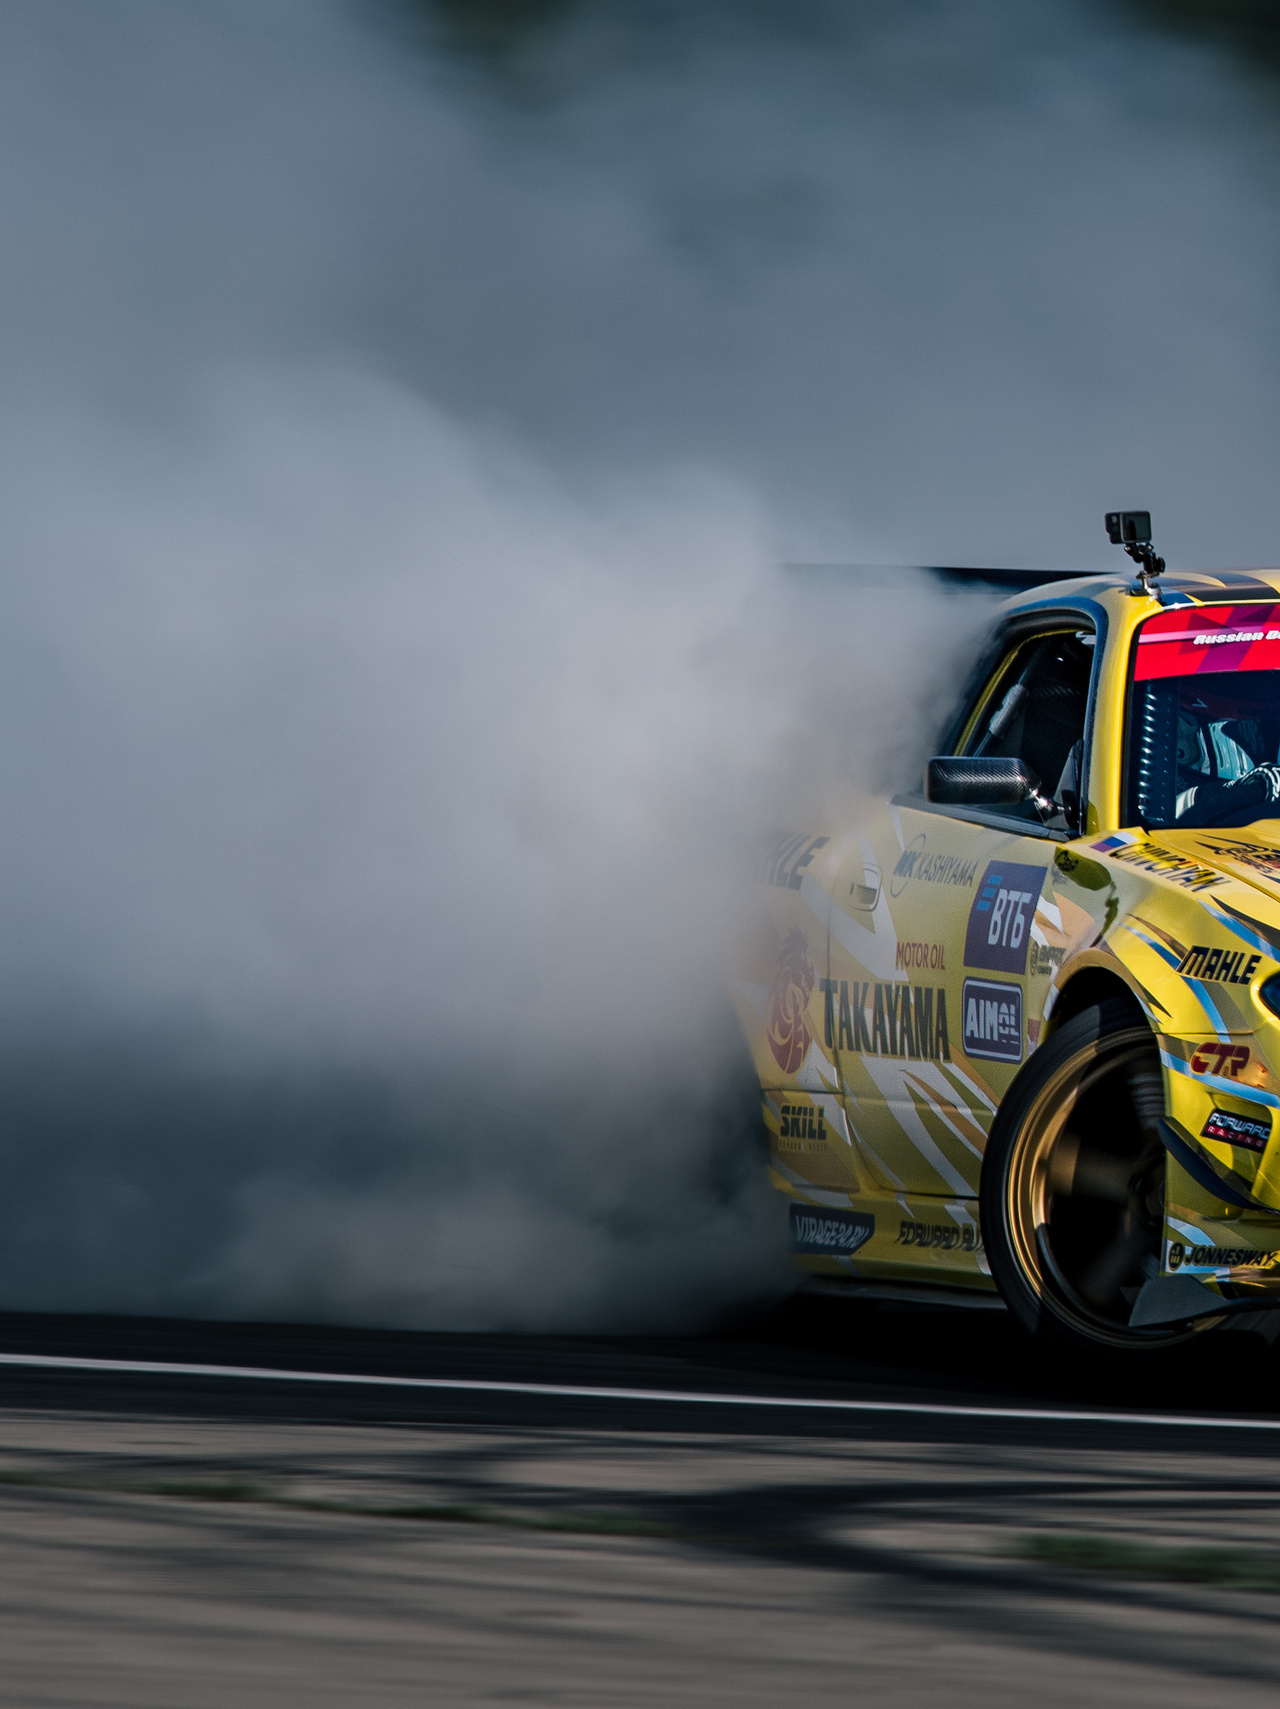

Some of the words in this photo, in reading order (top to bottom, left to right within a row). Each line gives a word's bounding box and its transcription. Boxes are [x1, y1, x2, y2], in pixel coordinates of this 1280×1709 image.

[1193, 630, 1263, 645] Russian
[896, 941, 928, 969] MOTOR
[930, 945, 946, 971] OIL
[1176, 945, 1262, 985] MAHLE
[819, 978, 951, 1061] TAKAYAMA
[965, 997, 1020, 1046] AIMOL
[780, 1104, 828, 1141] SKILL
[1206, 1125, 1265, 1148] RACING
[1208, 1112, 1270, 1139] FORWARD
[1184, 1245, 1277, 1268] JONNESWAY
